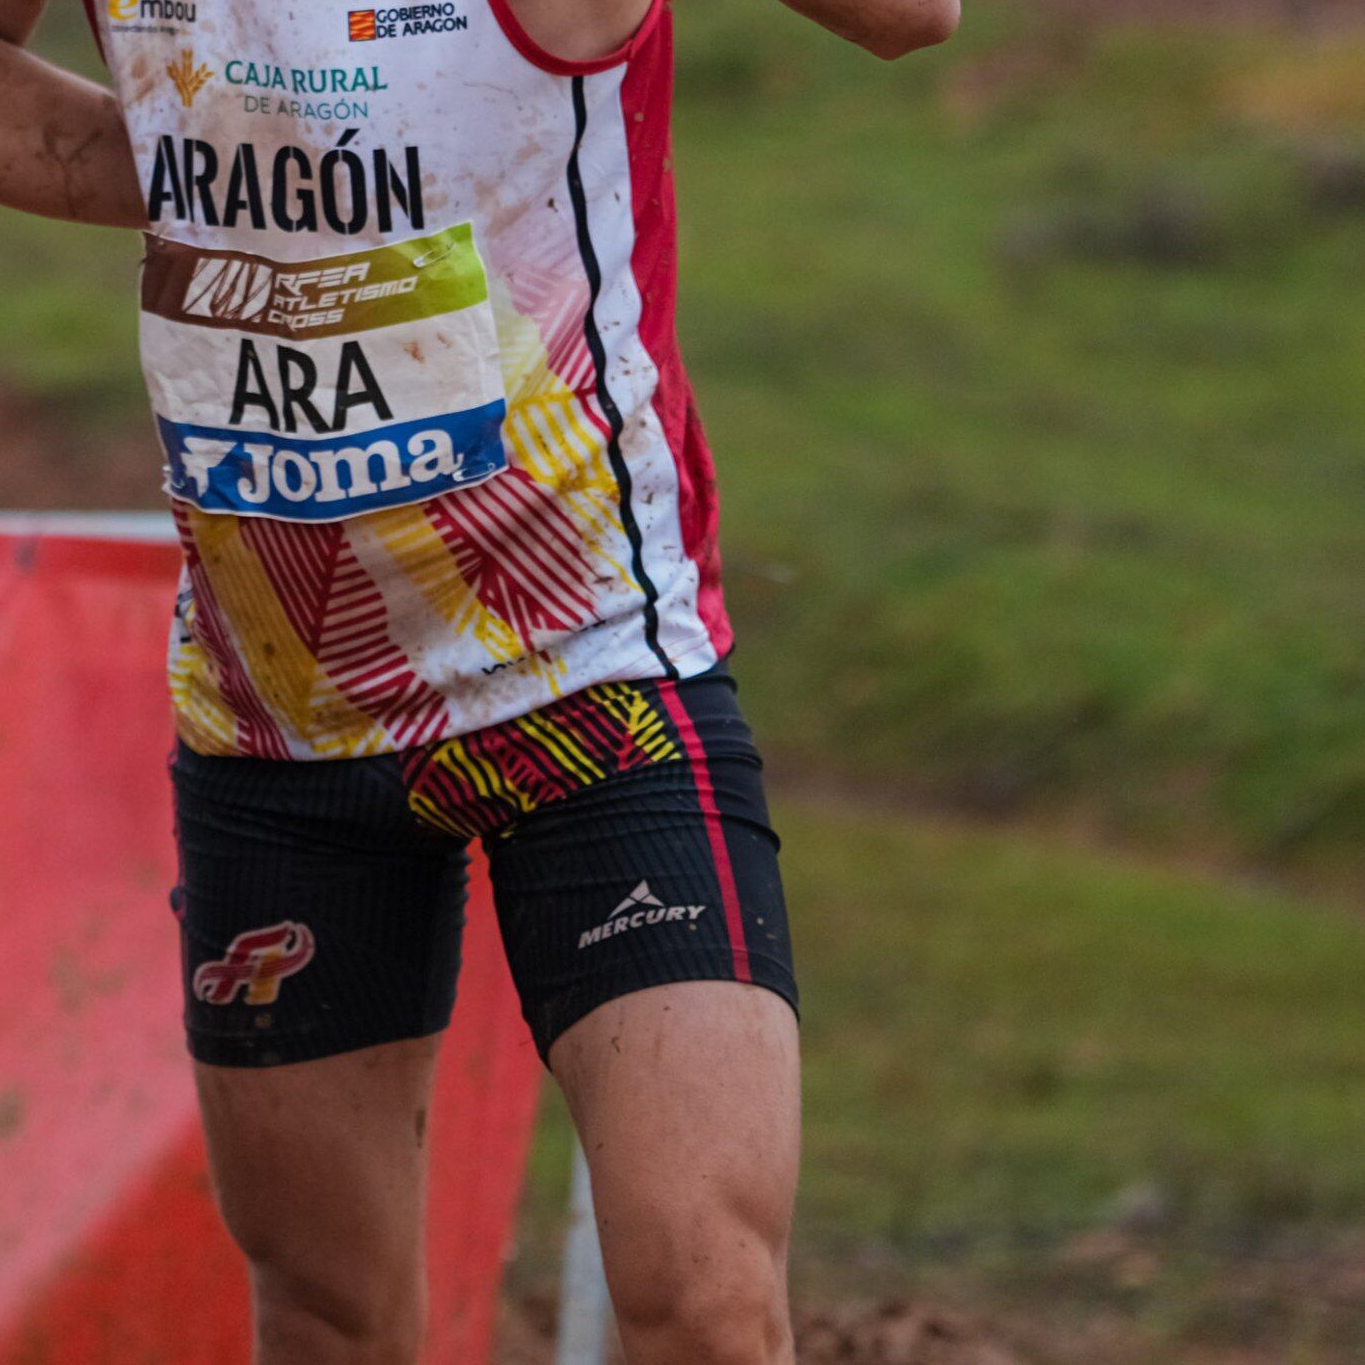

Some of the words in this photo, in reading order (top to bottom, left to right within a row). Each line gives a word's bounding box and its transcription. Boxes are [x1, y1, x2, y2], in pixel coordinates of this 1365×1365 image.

[376, 2, 455, 23] GOBIERNO
[376, 25, 397, 39] DE
[225, 60, 287, 90] CAJA
[291, 66, 388, 95] RURAL
[244, 95, 270, 115] DE
[277, 98, 368, 120] ARAGÓN
[148, 128, 424, 234] ARAGÓN
[273, 275, 418, 311] ATLETISMO
[275, 262, 371, 296] RFEA
[268, 308, 345, 331] CROSS
[229, 338, 393, 434] ARA
[577, 904, 707, 950] MERCURY
